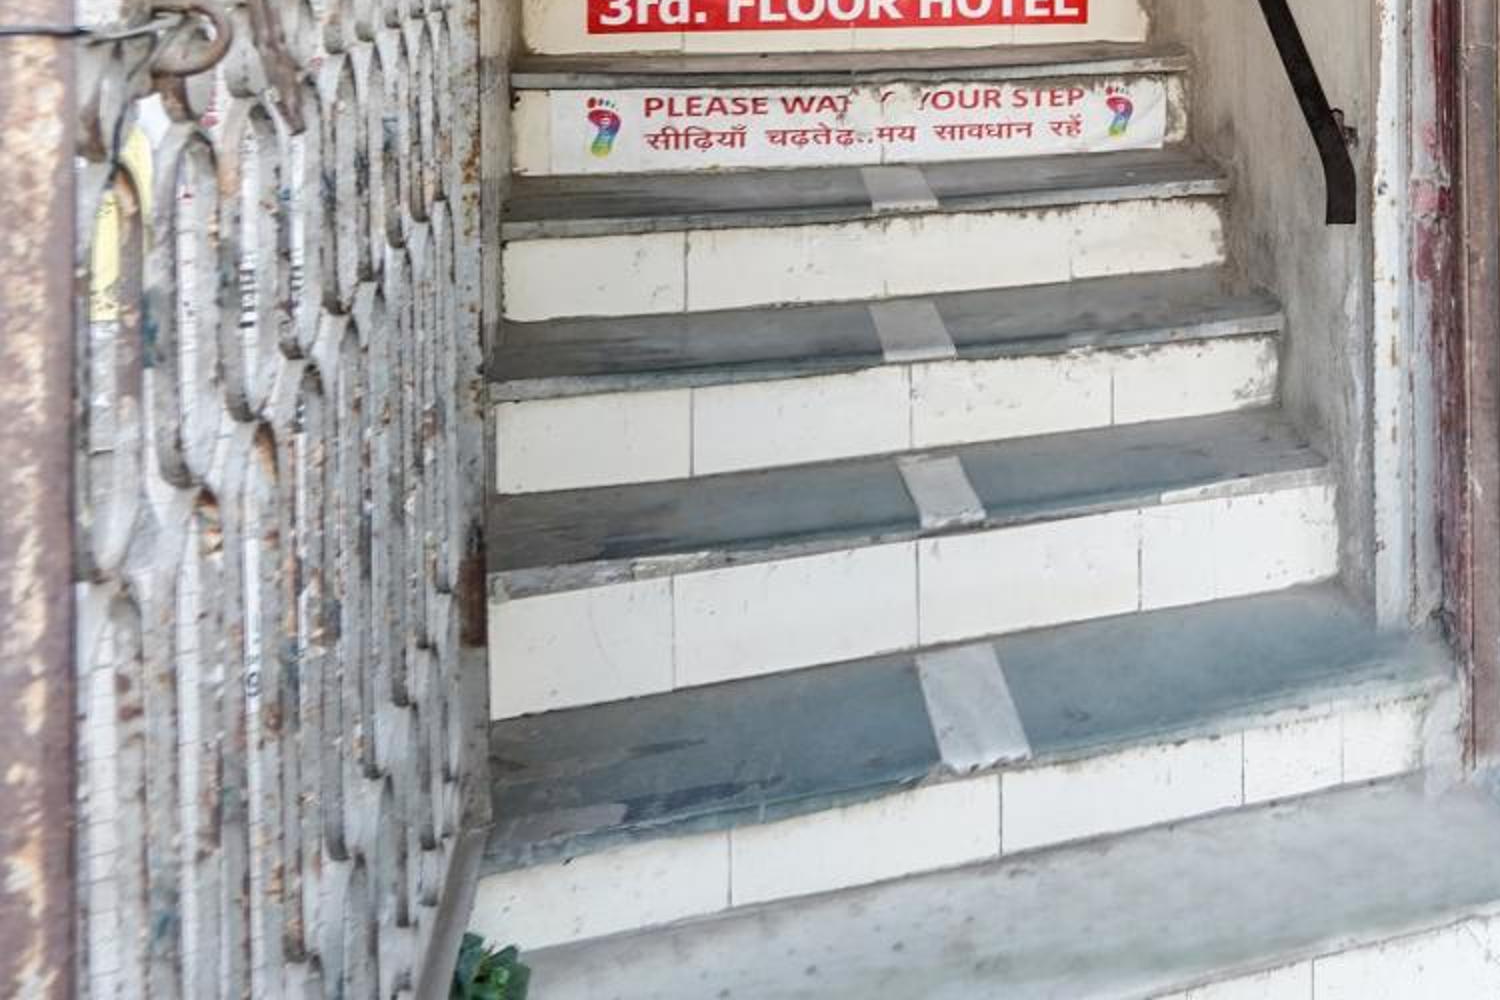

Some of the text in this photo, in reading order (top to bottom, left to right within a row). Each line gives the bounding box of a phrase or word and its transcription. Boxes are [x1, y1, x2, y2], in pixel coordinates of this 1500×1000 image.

[644, 95, 769, 118] PLEASE
[932, 118, 1033, 142] सावधान
[1048, 112, 1082, 138] रहें
